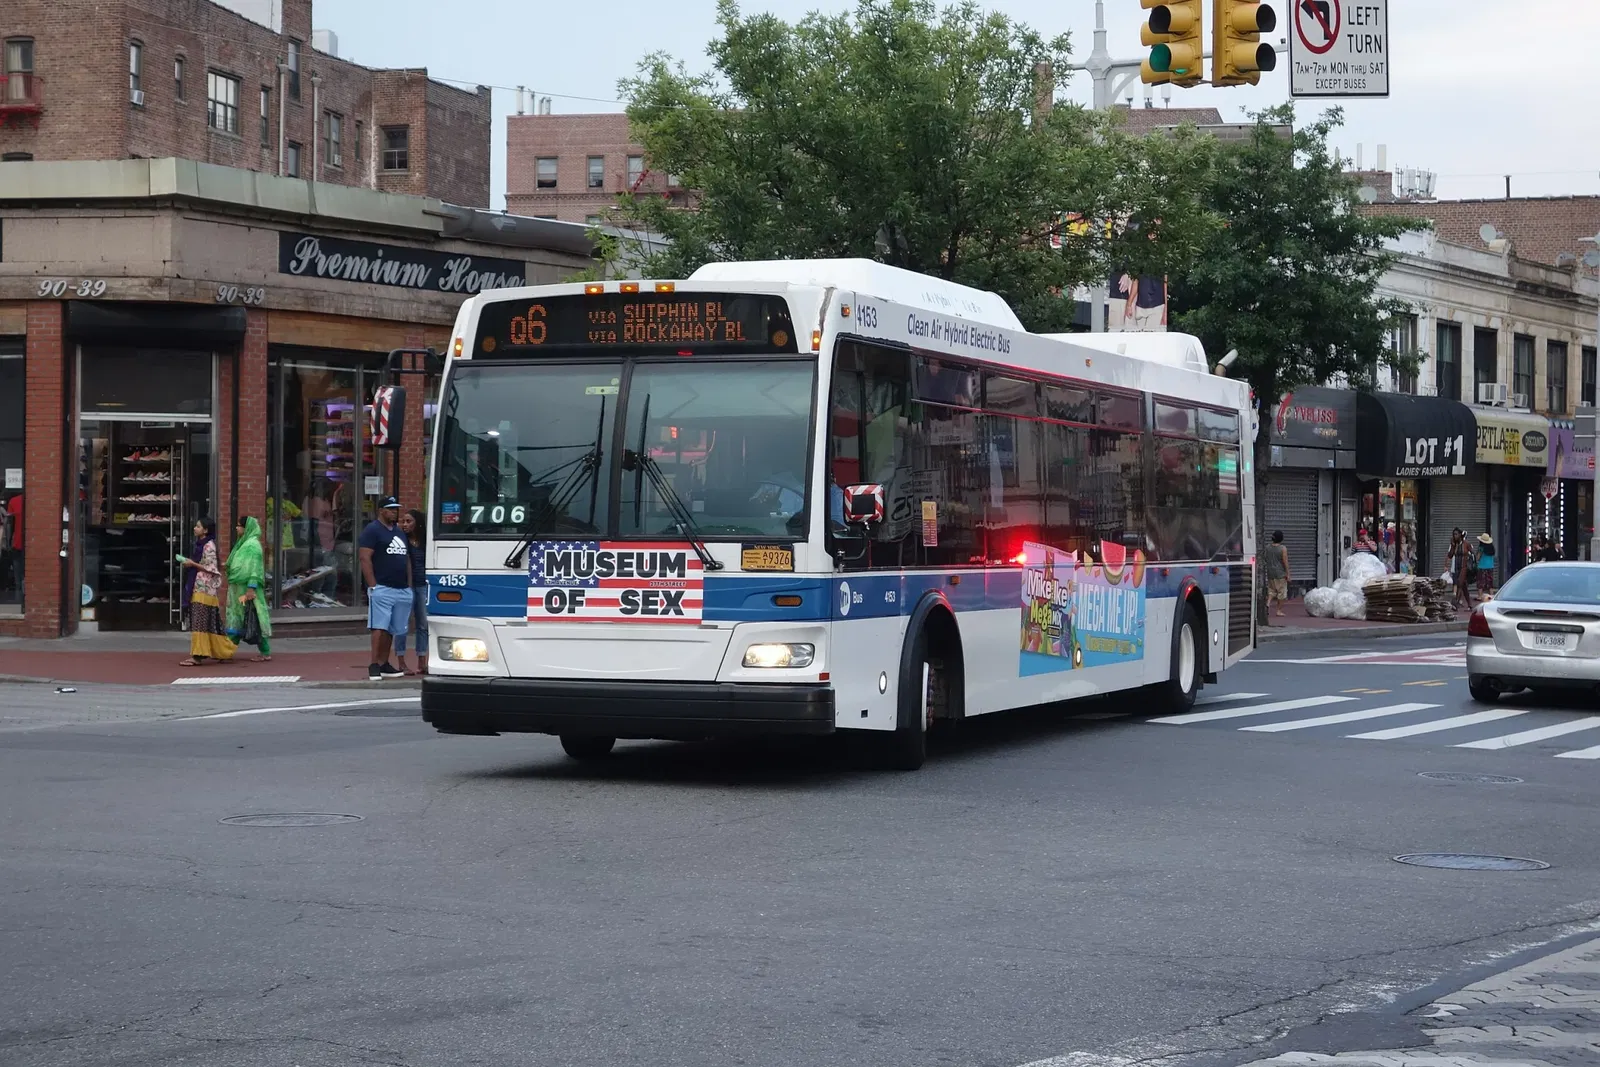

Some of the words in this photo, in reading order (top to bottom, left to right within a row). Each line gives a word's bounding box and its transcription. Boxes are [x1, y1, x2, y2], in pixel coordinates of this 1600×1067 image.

[1347, 5, 1380, 26] LEFT
[1347, 34, 1382, 54] TURN
[1330, 61, 1349, 75] MON
[1351, 64, 1367, 75] THRU
[1369, 62, 1384, 75] SAT
[1315, 78, 1342, 89] EXCEPT
[1344, 78, 1367, 89] BUSES
[289, 236, 432, 287] Premium
[37, 279, 107, 297] 90-39
[216, 284, 265, 305] 90-39
[588, 310, 616, 323] VIA
[623, 302, 699, 322] SUTPHIN
[856, 304, 878, 329] 4153
[510, 304, 548, 344] Q6
[588, 330, 616, 343] VIA
[623, 322, 718, 342] ROCKAWAY
[724, 321, 746, 341] BL
[907, 313, 929, 336] Clean
[930, 318, 942, 341] Air
[944, 321, 969, 347] Hybrid
[970, 327, 996, 351] Electric
[998, 333, 1011, 354] Bus
[1404, 437, 1438, 465] LOT
[1421, 466, 1448, 476] FASHION
[470, 506, 525, 523] 706
[545, 551, 686, 579] MUSEUM
[438, 575, 467, 587] 4153
[1028, 569, 1052, 600] Mike
[1054, 582, 1068, 608] Ike
[544, 588, 586, 614] OF
[619, 589, 686, 616] SEX
[853, 591, 863, 604] Bus
[1030, 599, 1052, 632] Mega
[1077, 582, 1105, 632] MEGA
[1107, 586, 1122, 635] ME
